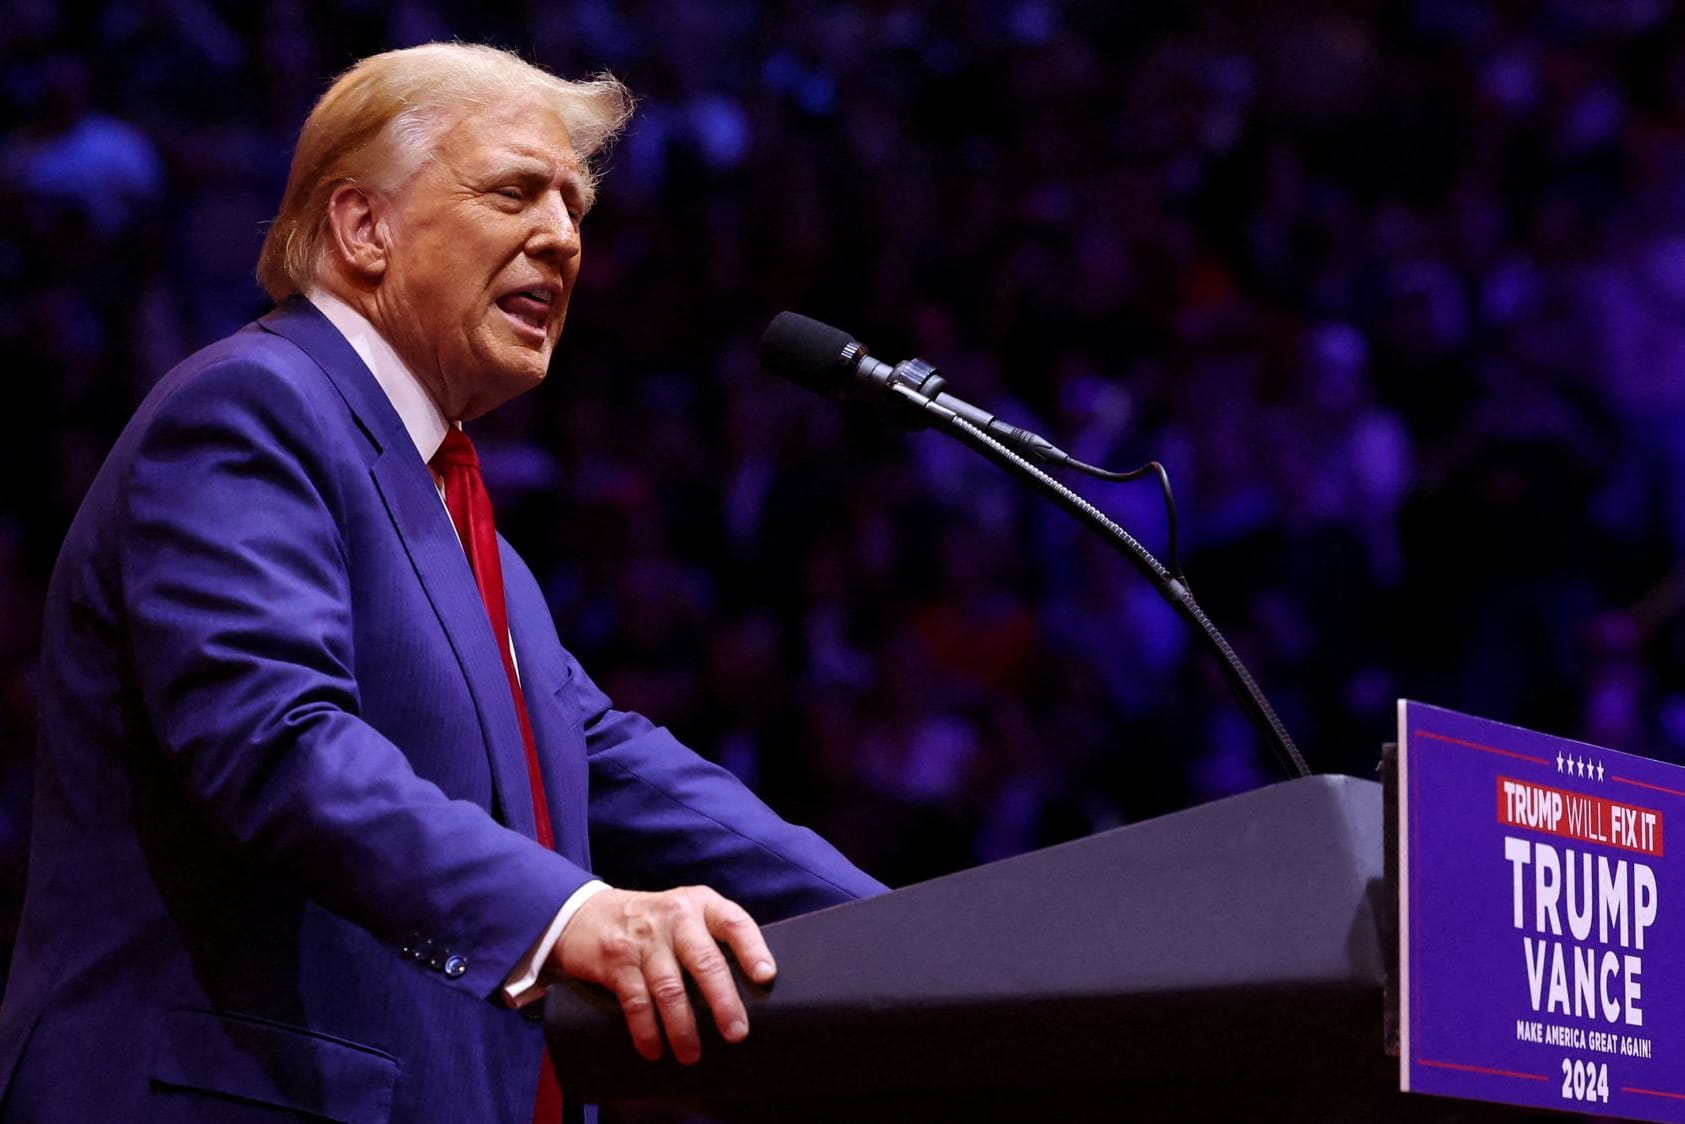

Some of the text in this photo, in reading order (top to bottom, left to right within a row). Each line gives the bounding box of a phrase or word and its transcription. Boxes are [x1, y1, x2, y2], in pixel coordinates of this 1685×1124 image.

[1504, 781, 1656, 851] TRUMP WILL FIX IT
[1504, 836, 1658, 950] TRUMP
[1523, 937, 1643, 1026] VANCE
[1516, 1020, 1652, 1058] MAKE AMERICA GREAT AGAIN!
[1561, 1058, 1609, 1103] 2024
